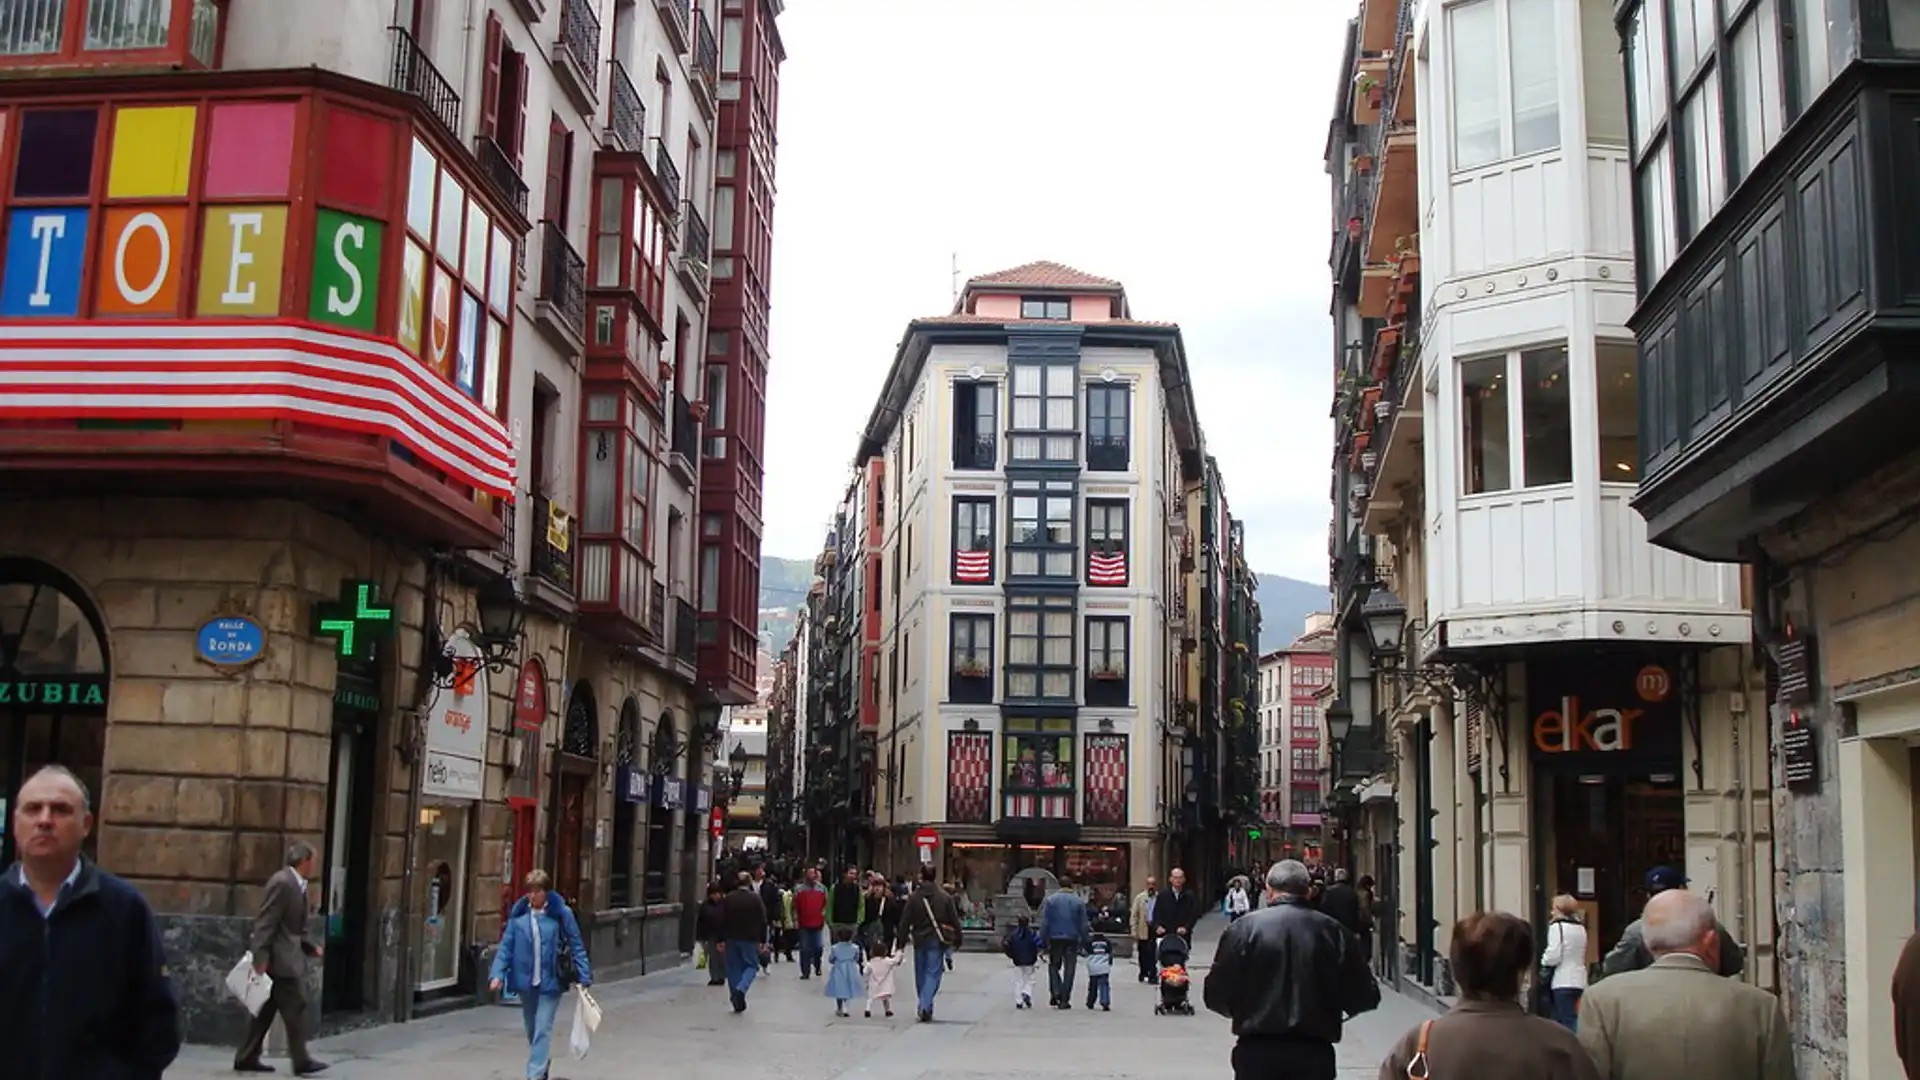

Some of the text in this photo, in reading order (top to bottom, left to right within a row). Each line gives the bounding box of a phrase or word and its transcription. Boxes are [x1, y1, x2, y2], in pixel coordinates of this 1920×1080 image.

[29, 212, 365, 317] TOES
[0, 682, 104, 704] ZUBIA
[1534, 696, 1645, 752] elkar
